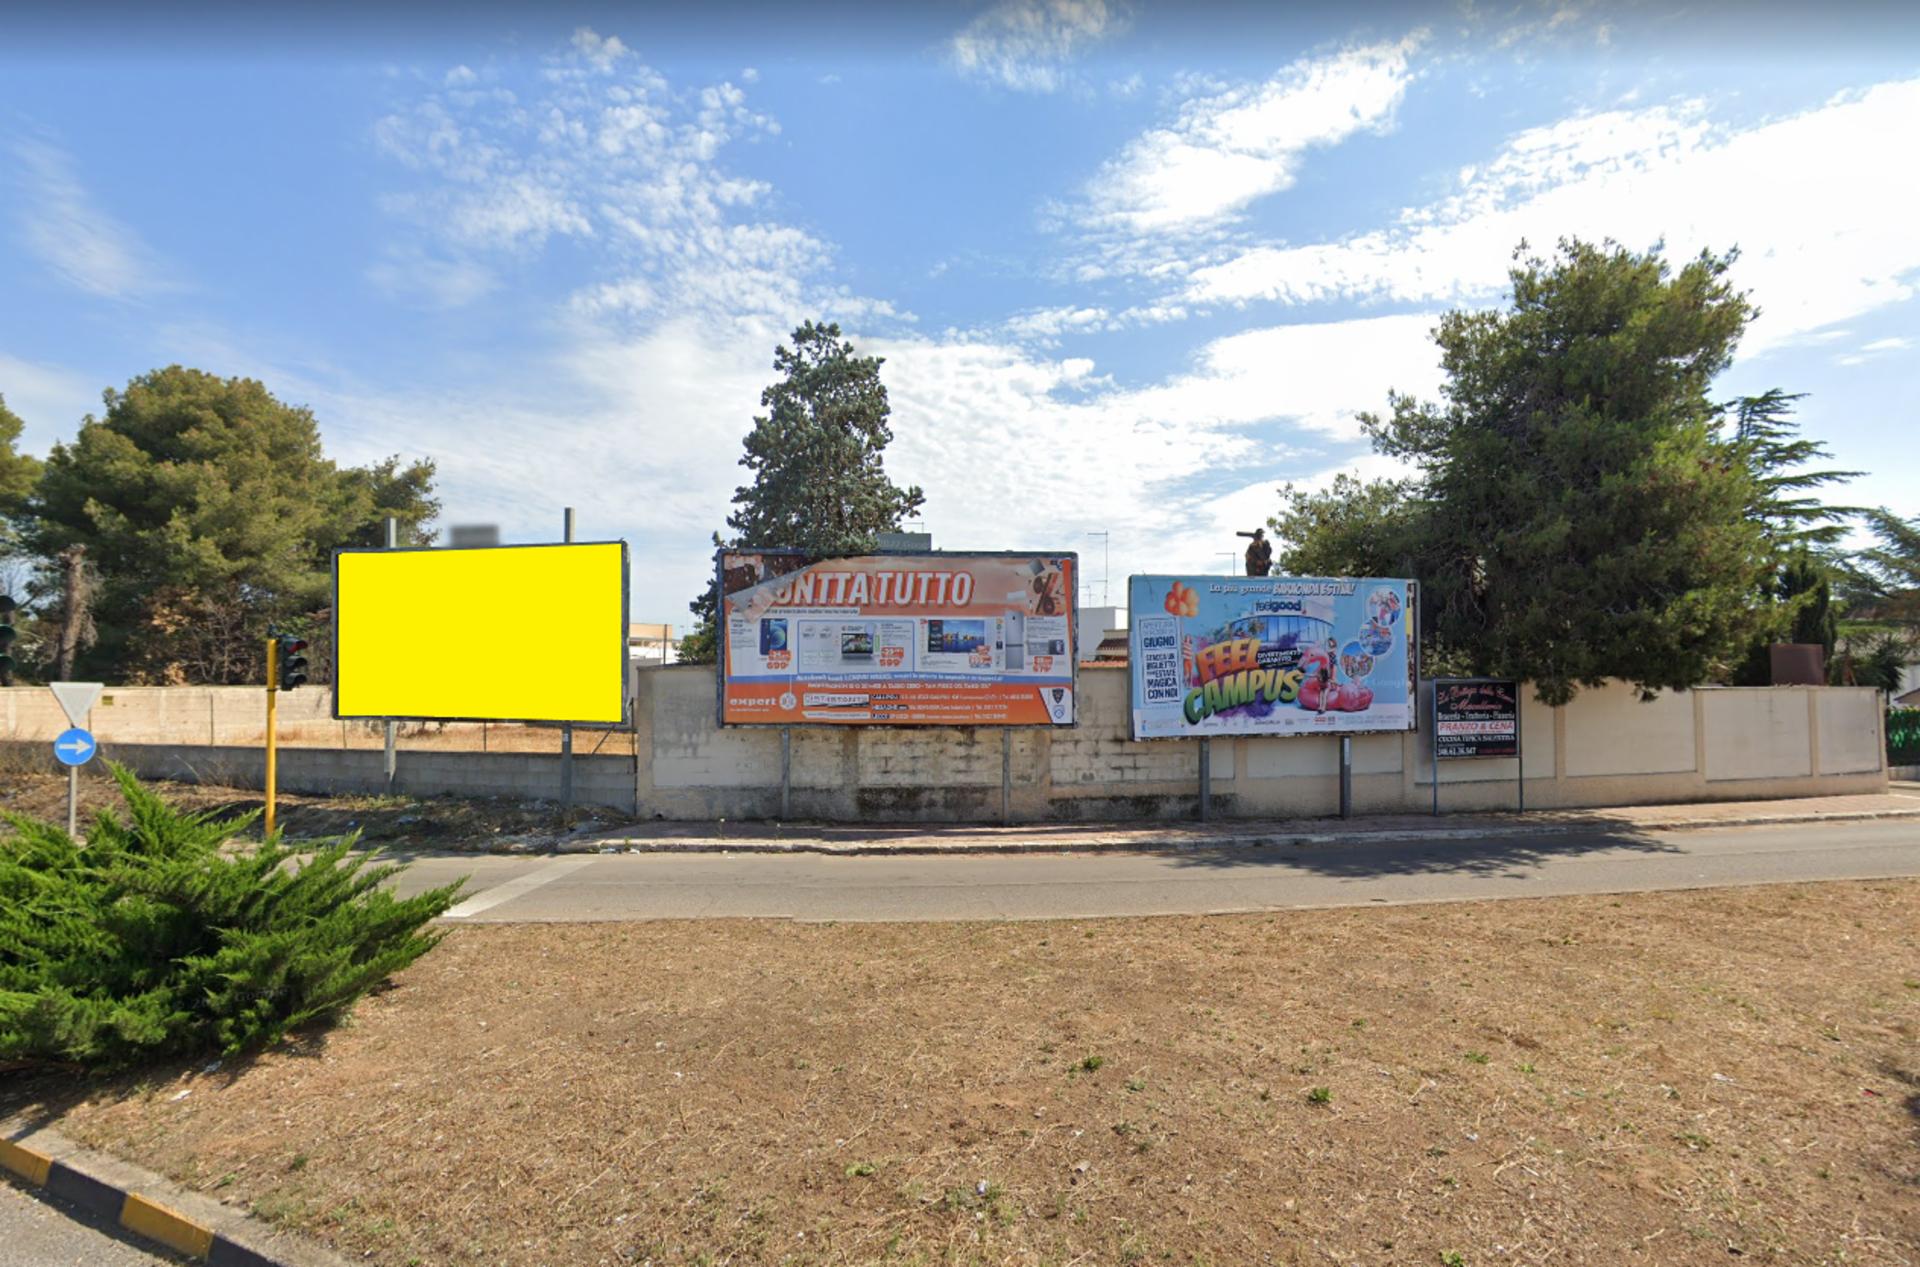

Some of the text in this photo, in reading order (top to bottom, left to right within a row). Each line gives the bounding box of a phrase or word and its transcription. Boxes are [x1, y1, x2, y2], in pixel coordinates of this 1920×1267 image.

[877, 573, 974, 607] TUTTO
[1143, 636, 1175, 648] GIUGNO
[1196, 638, 1261, 683] FEEL
[1147, 677, 1178, 689] MAGICA
[1147, 688, 1178, 700] CON NOI
[1183, 669, 1304, 725] CAMPUS
[730, 698, 777, 707] expert
[1439, 720, 1514, 732] PRANZO & CENA
